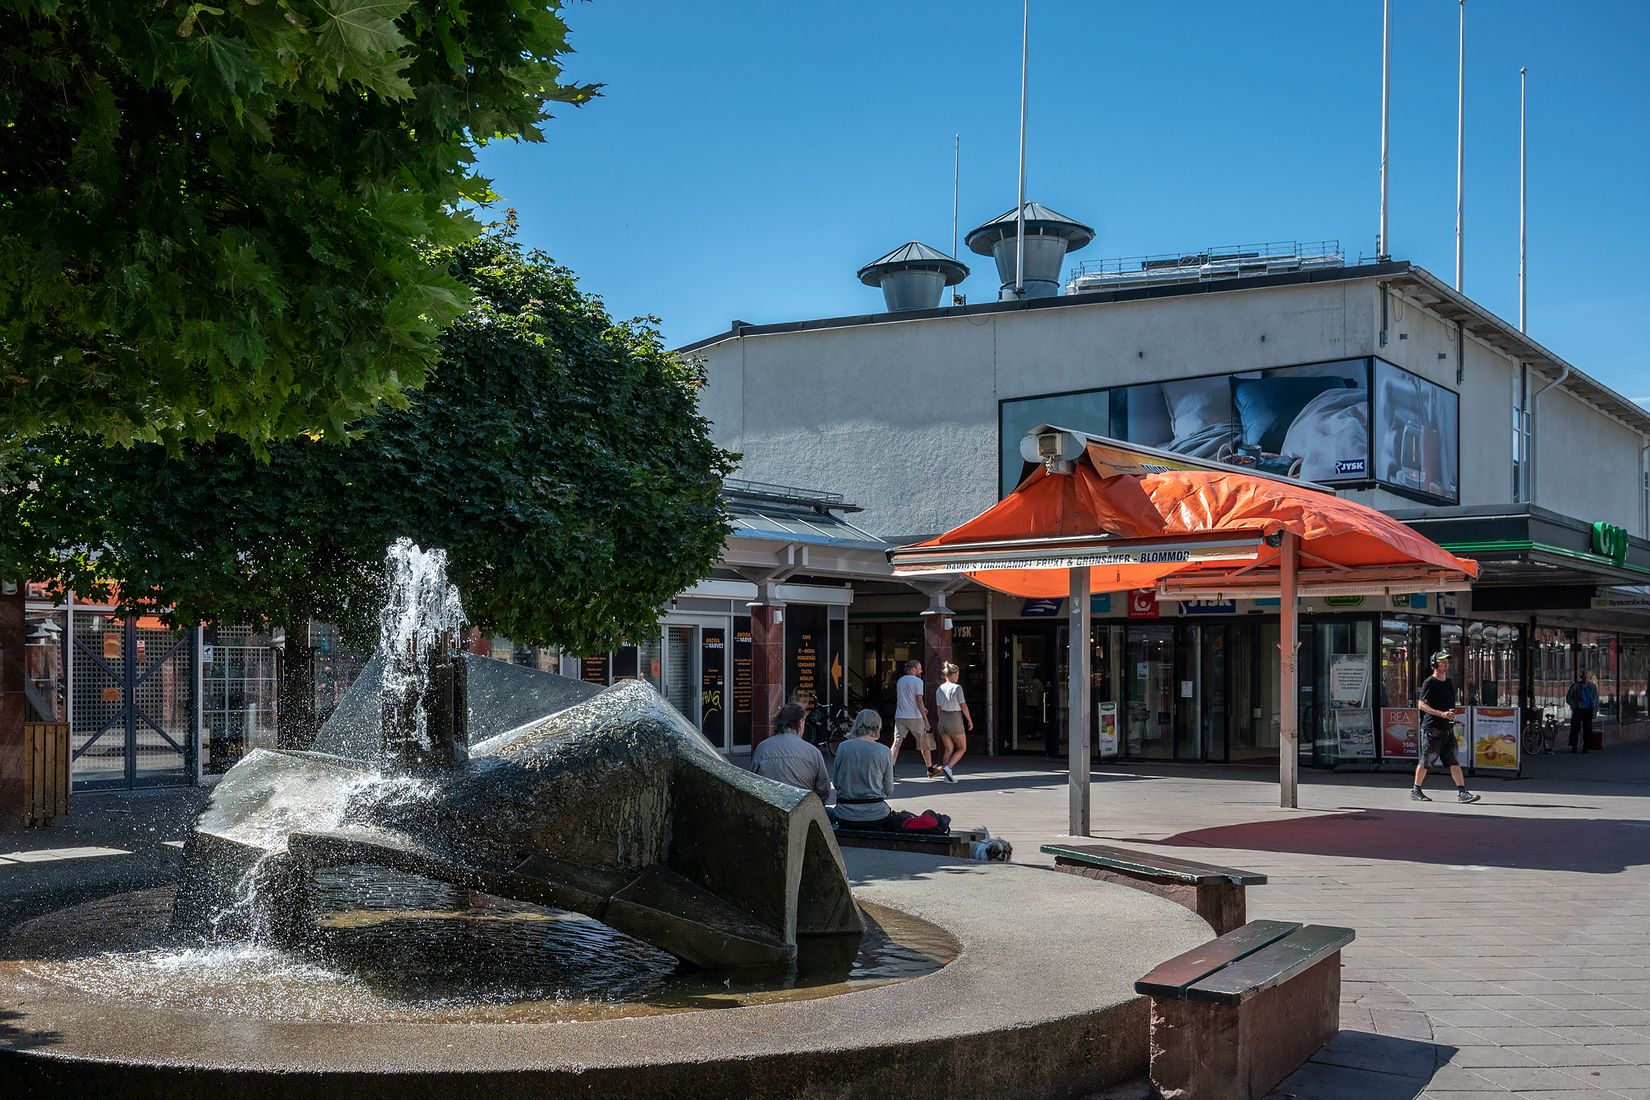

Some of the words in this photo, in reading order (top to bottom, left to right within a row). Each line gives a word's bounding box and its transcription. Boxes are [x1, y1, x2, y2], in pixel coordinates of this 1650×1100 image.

[1341, 461, 1364, 471] JYSK
[1066, 556, 1074, 567] &
[1140, 550, 1190, 563] BLOMMOR
[1608, 598, 1650, 607] Systembola
[953, 625, 972, 638] JYSK
[1390, 711, 1410, 722] REA
